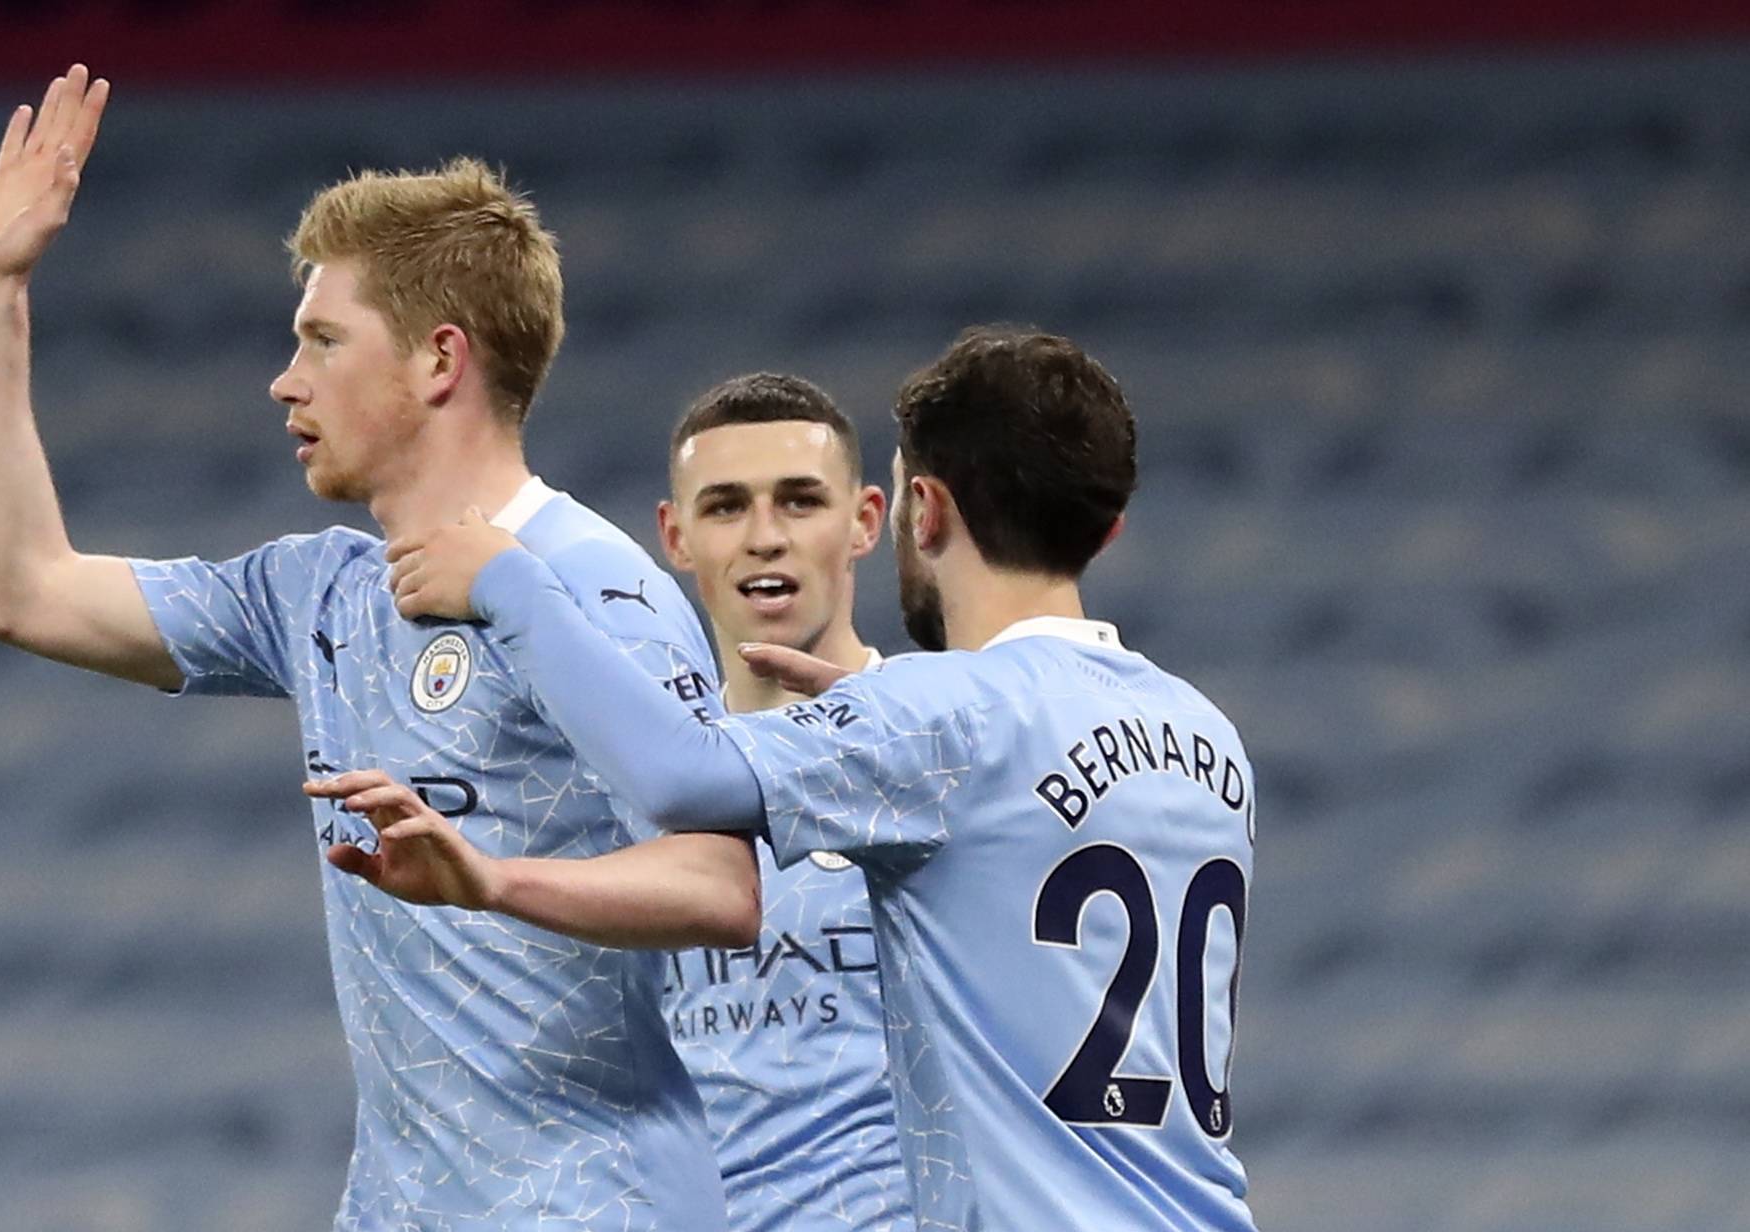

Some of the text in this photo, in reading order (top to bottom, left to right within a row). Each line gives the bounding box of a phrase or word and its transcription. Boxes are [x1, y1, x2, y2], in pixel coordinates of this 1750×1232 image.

[1035, 717, 1254, 849] BERNARD
[673, 993, 839, 1040] AIRWAYS
[1032, 842, 1246, 1140] 20
